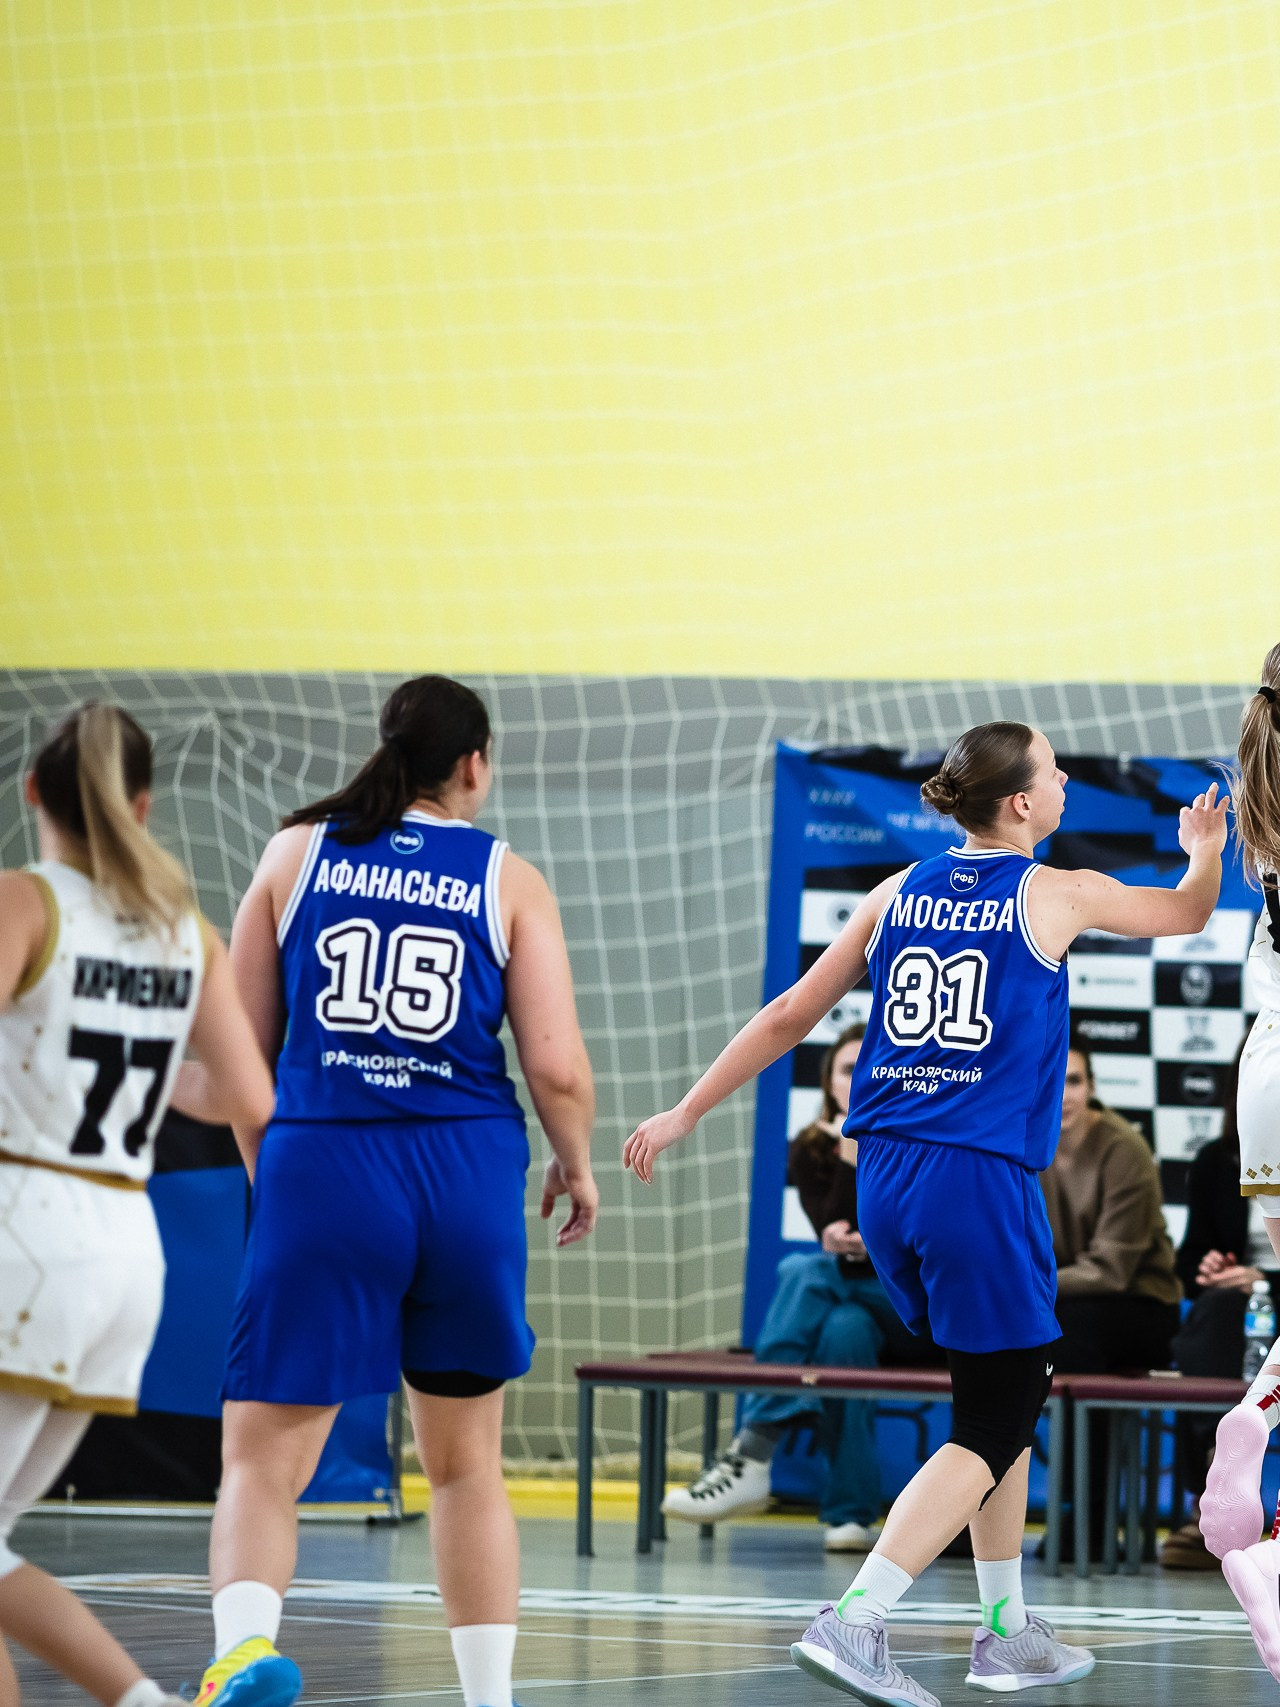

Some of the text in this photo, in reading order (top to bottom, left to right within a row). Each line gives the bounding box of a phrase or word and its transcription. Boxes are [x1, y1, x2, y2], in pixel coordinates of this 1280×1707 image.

[313, 858, 482, 918] АФАНАСЬЕВА
[953, 872, 975, 884] РФБ
[890, 893, 1015, 933] МОСЕЕВА
[315, 917, 466, 1044] 15
[883, 946, 994, 1052] 31
[68, 1028, 175, 1157] 77
[871, 1066, 983, 1083] КРАСНОЯРСКИЙ
[902, 1079, 939, 1095] КРАЙ
